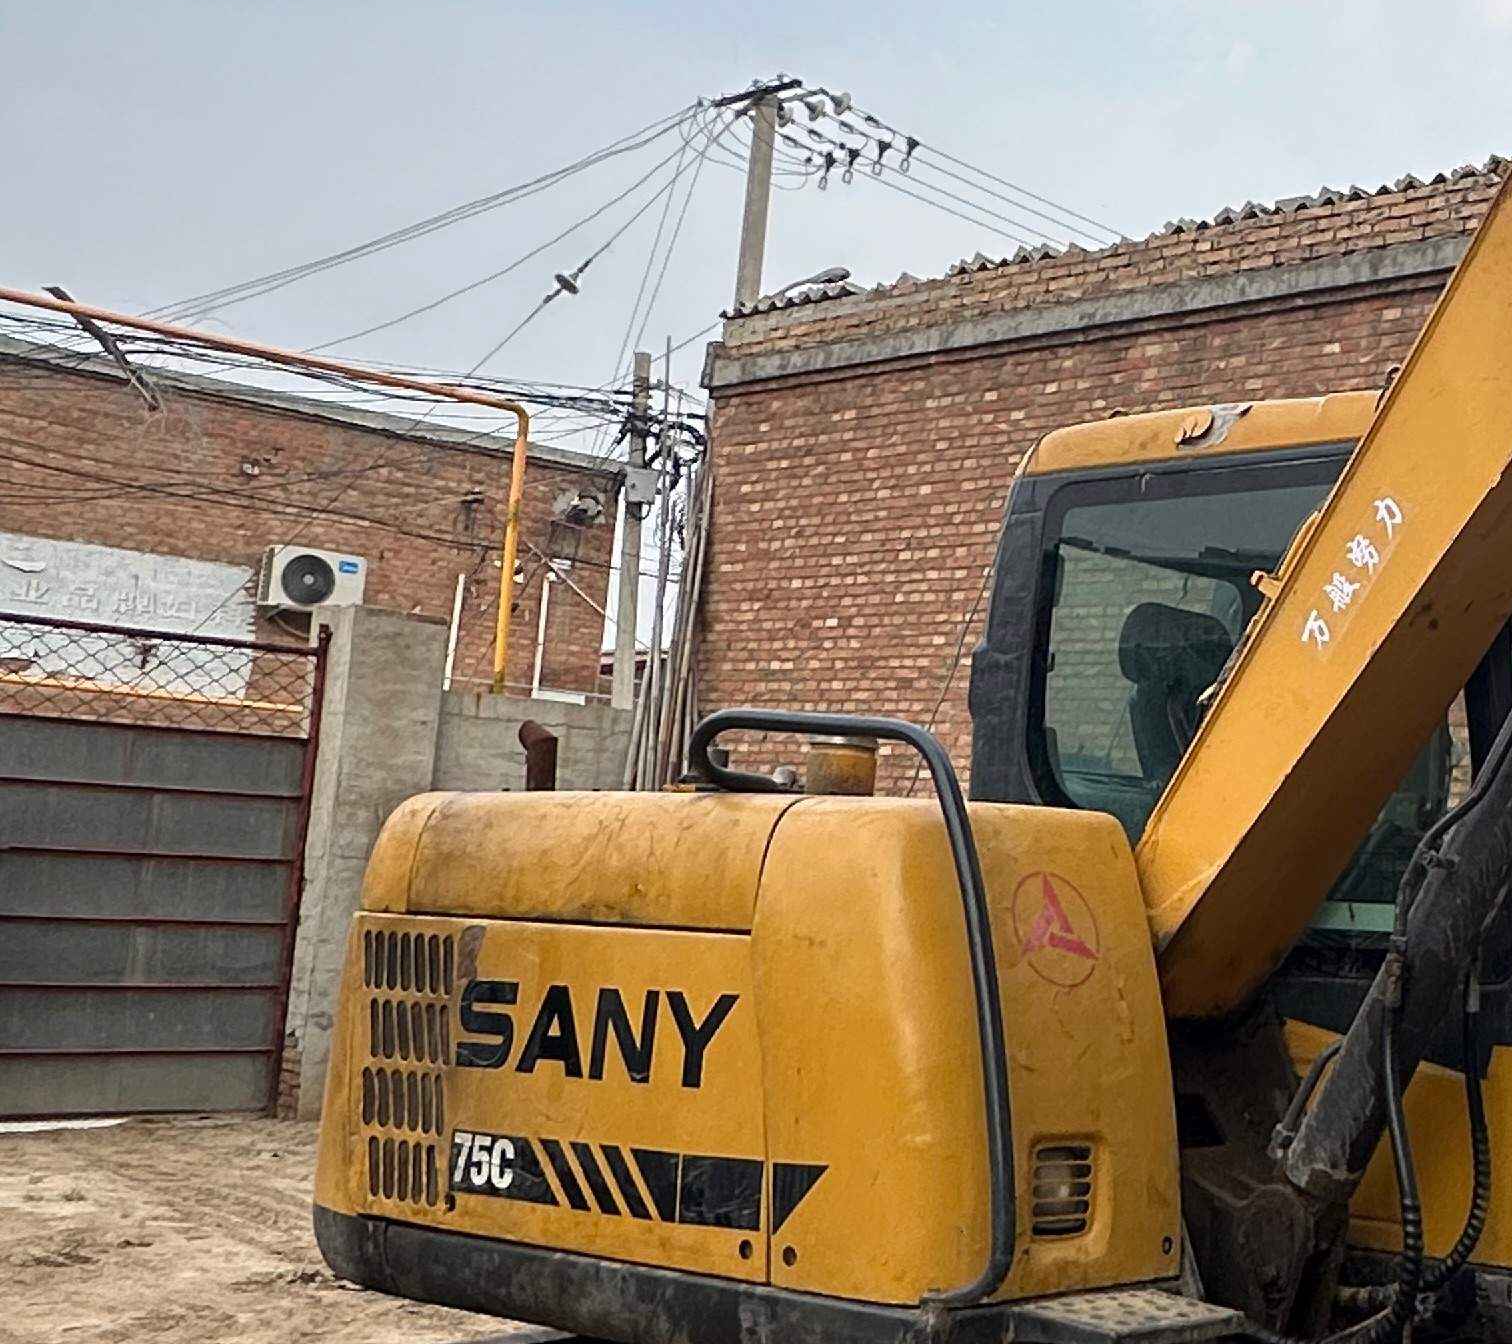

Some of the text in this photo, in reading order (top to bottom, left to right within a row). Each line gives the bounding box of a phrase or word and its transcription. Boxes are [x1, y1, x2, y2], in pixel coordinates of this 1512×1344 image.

[1300, 497, 1402, 651] 万般努力
[455, 978, 741, 1088] SANY
[453, 1132, 516, 1189] 75C
